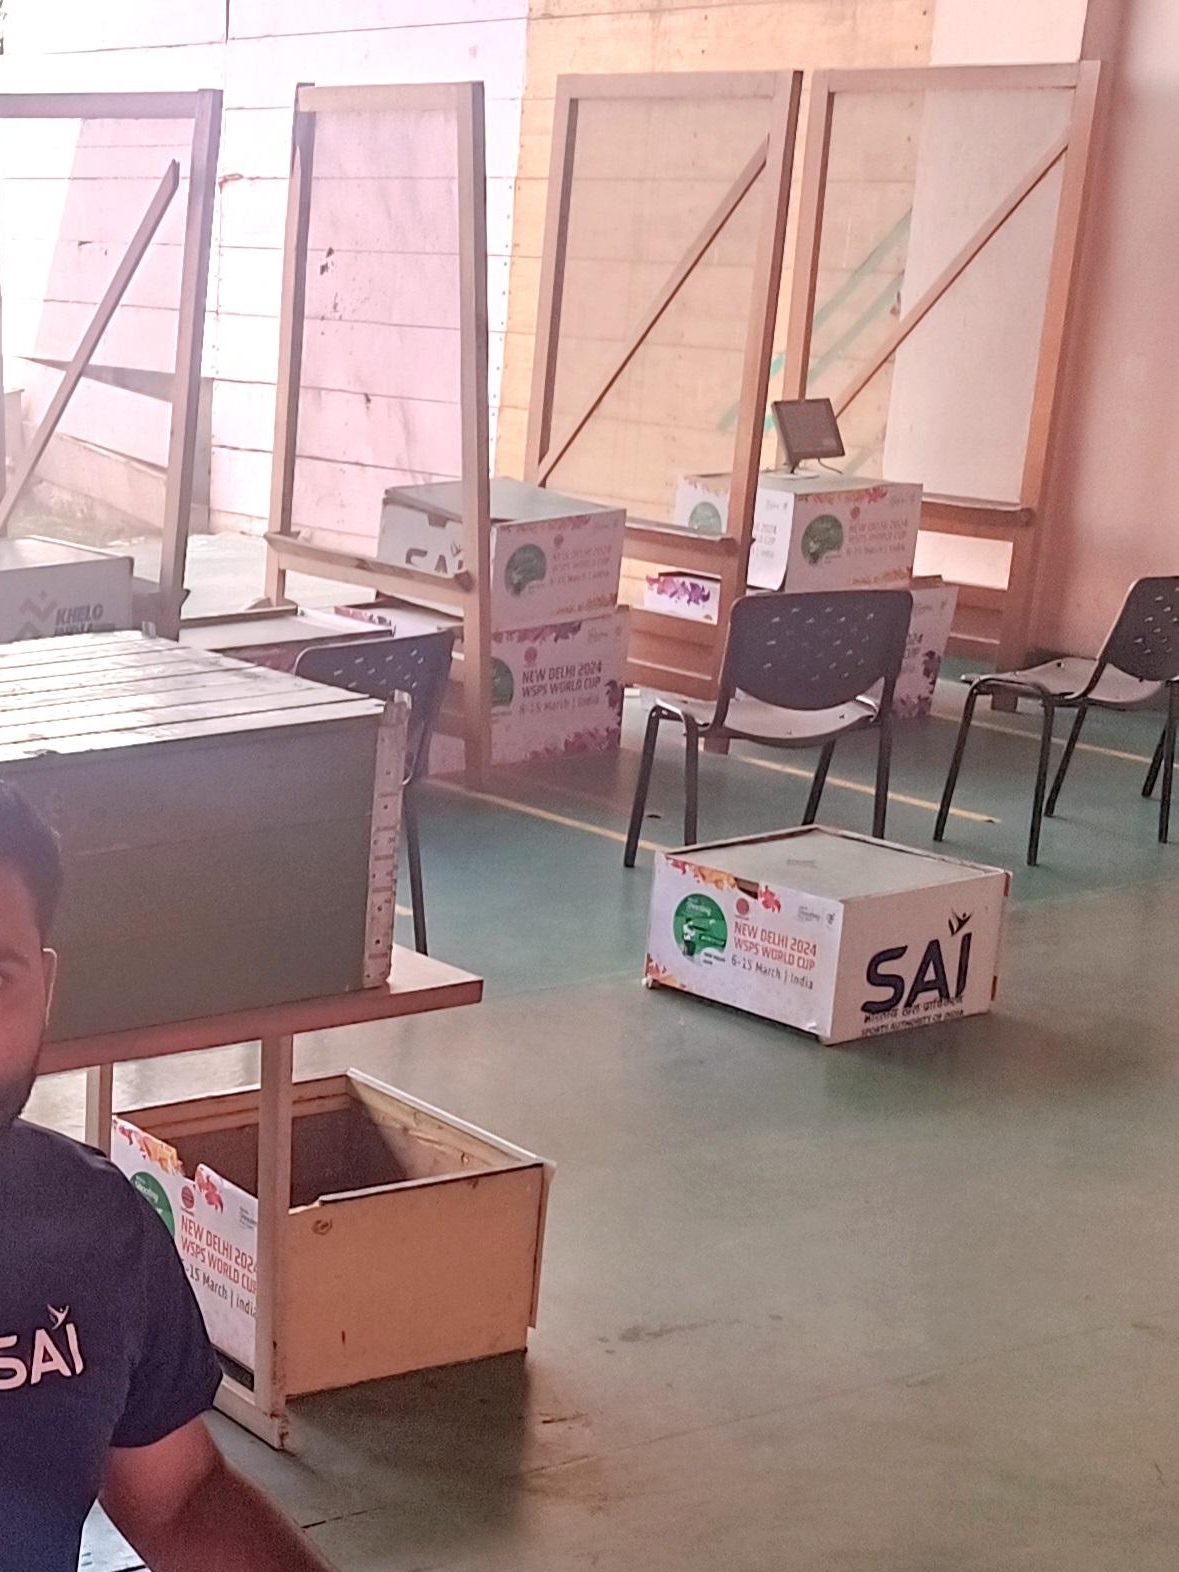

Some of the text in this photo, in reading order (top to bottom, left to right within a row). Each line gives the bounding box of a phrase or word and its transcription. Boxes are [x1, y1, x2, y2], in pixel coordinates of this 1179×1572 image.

[56, 603, 105, 625] KHELO
[548, 664, 576, 681] DELHI
[584, 675, 601, 690] CUP
[734, 921, 817, 957] NEW DELHI 2024
[734, 937, 760, 955] WSPS
[762, 946, 795, 966] WORLD
[796, 956, 815, 971] CUP
[755, 961, 781, 980] March
[790, 973, 814, 990] India
[861, 932, 973, 1014] SAI
[181, 1215, 204, 1242] NEW
[206, 1230, 232, 1261] DELHI
[181, 1236, 206, 1263] WSPS
[207, 1250, 239, 1284] WORLD
[182, 1258, 200, 1281] -15
[203, 1272, 228, 1300] March
